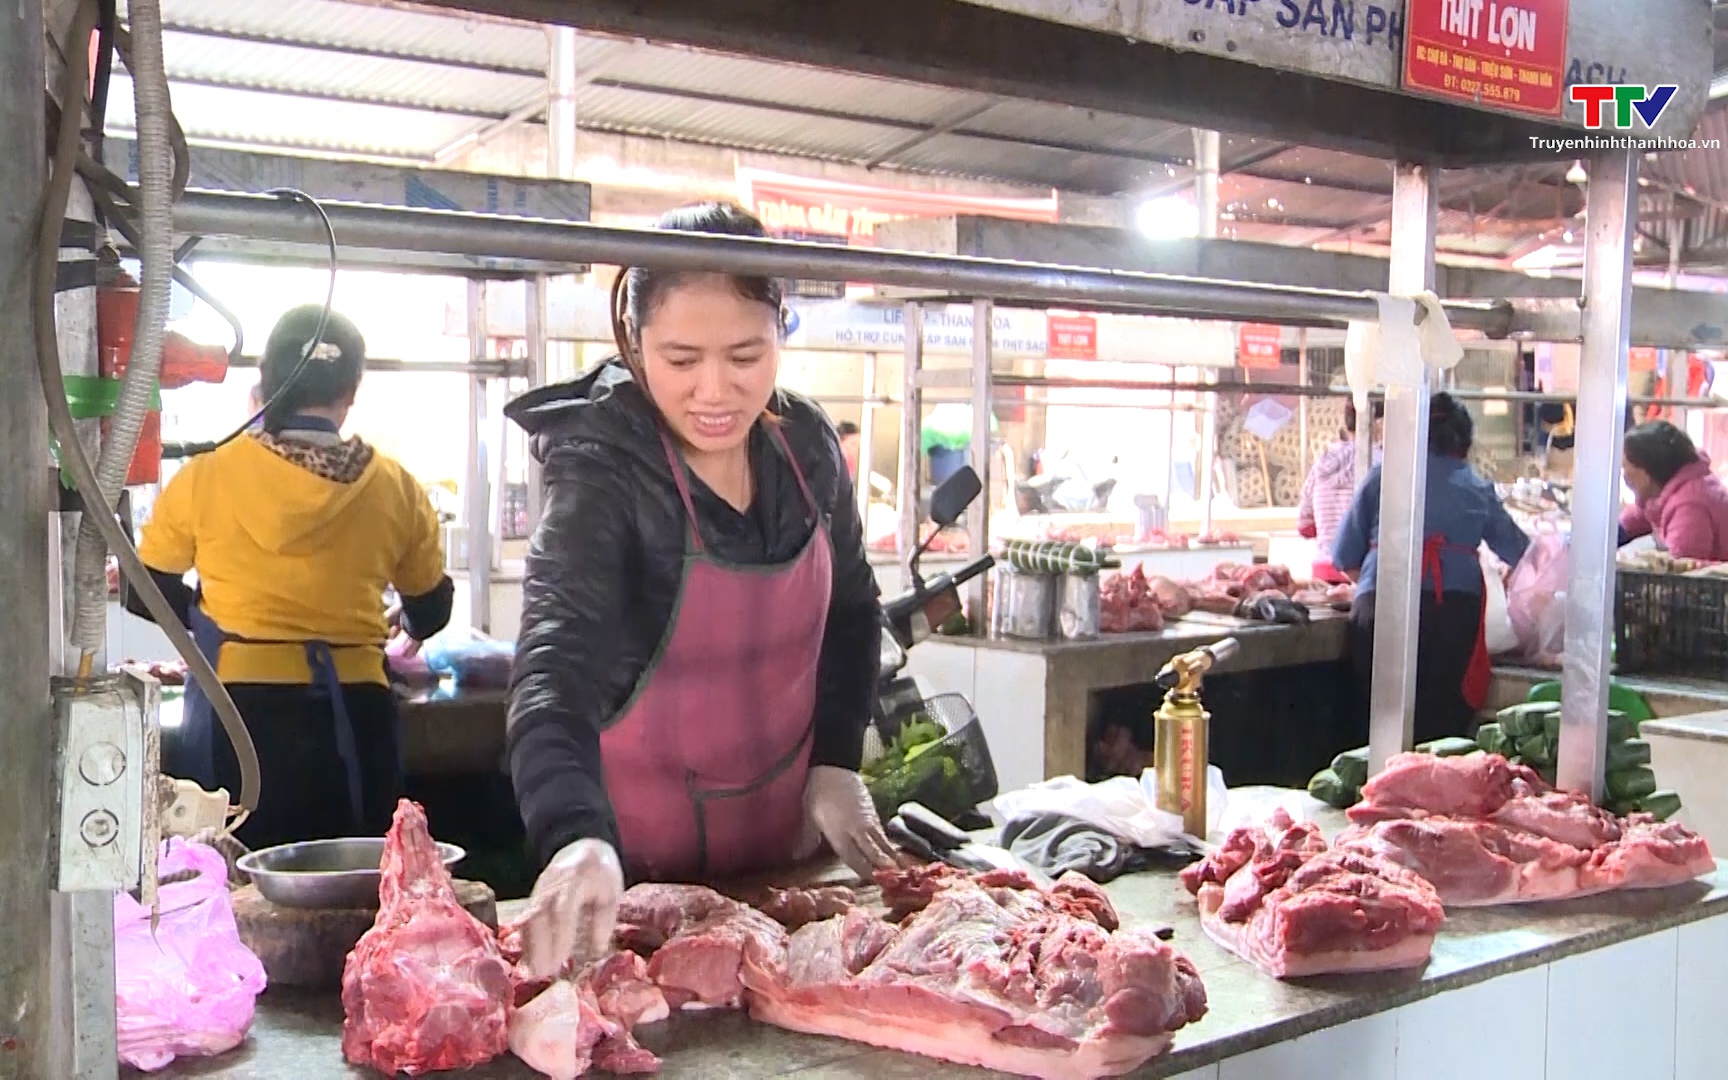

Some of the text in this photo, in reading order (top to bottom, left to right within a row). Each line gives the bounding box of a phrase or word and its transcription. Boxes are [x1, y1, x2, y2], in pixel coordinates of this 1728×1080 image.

[1366, 5, 1401, 50] PH
[1440, 0, 1537, 57] THỊT LỢN
[939, 313, 974, 328] THAN
